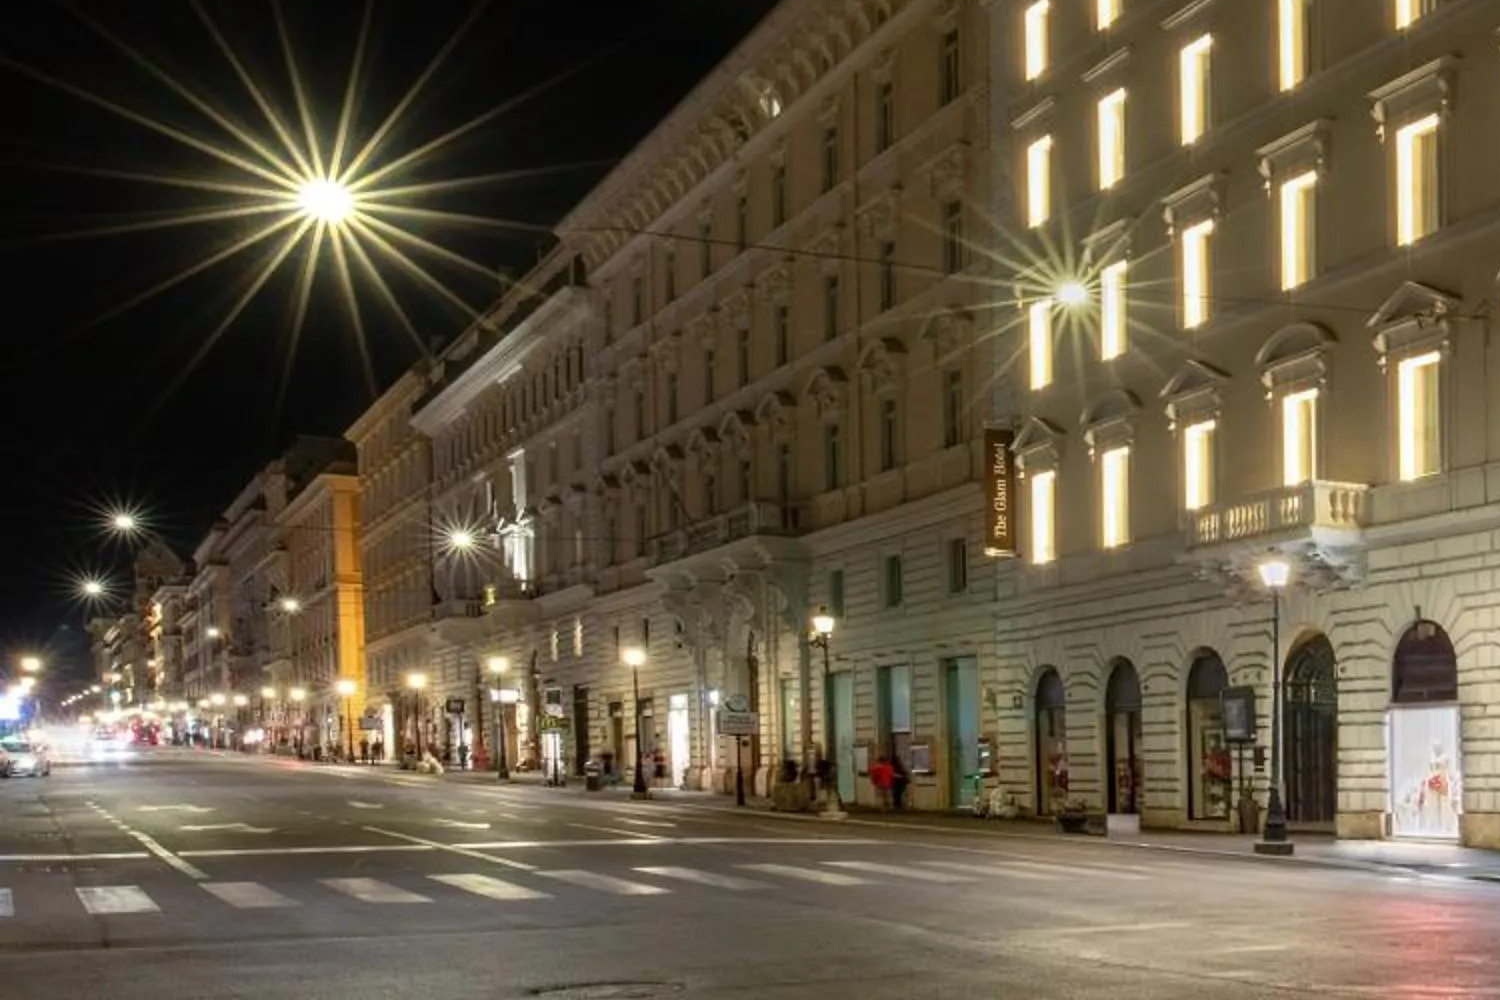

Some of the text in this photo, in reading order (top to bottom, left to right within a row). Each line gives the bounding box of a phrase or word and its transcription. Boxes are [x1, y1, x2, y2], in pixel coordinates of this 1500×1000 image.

[993, 442, 1007, 537] The Glam Hotel
